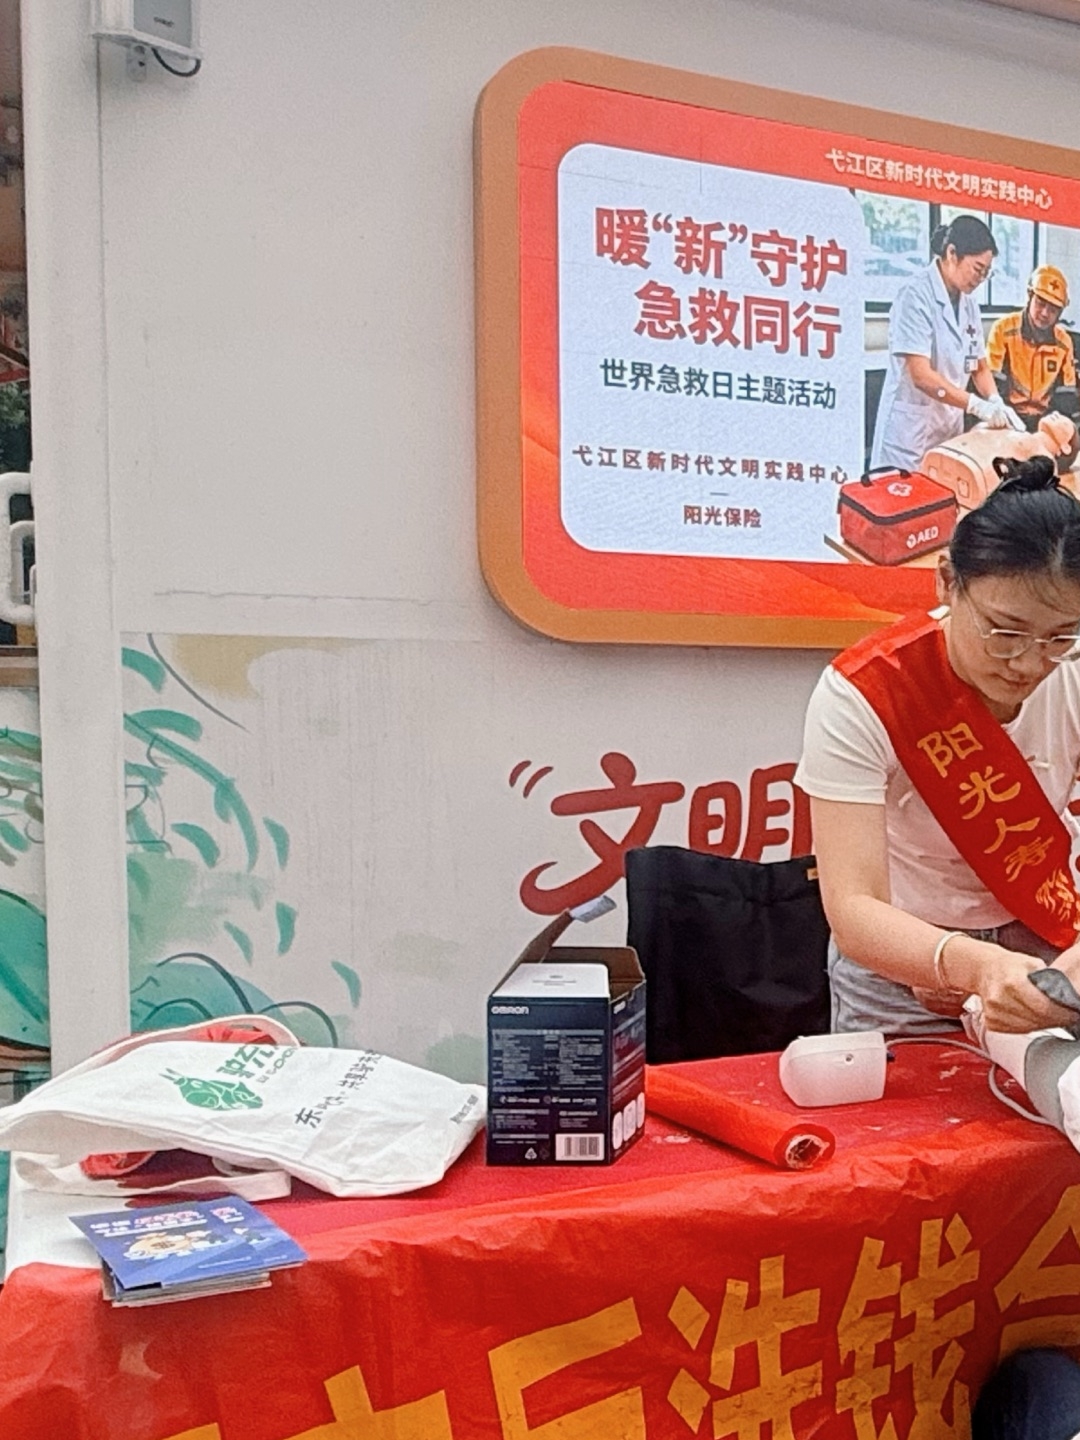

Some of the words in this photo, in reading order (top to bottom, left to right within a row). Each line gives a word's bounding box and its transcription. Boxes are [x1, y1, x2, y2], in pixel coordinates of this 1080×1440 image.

[825, 149, 1053, 210] 弋江区新时代文明实践中心
[595, 207, 848, 289] 暖“新”守护
[634, 281, 843, 358] 急救同行
[600, 358, 837, 410] 世界急救日主题活动
[573, 444, 849, 485] 弋江区新时代文明实践中心
[683, 503, 762, 529] 阳光保险
[917, 526, 939, 544] AED
[917, 722, 1055, 883] 阳光人寿
[519, 752, 814, 916] 文明
